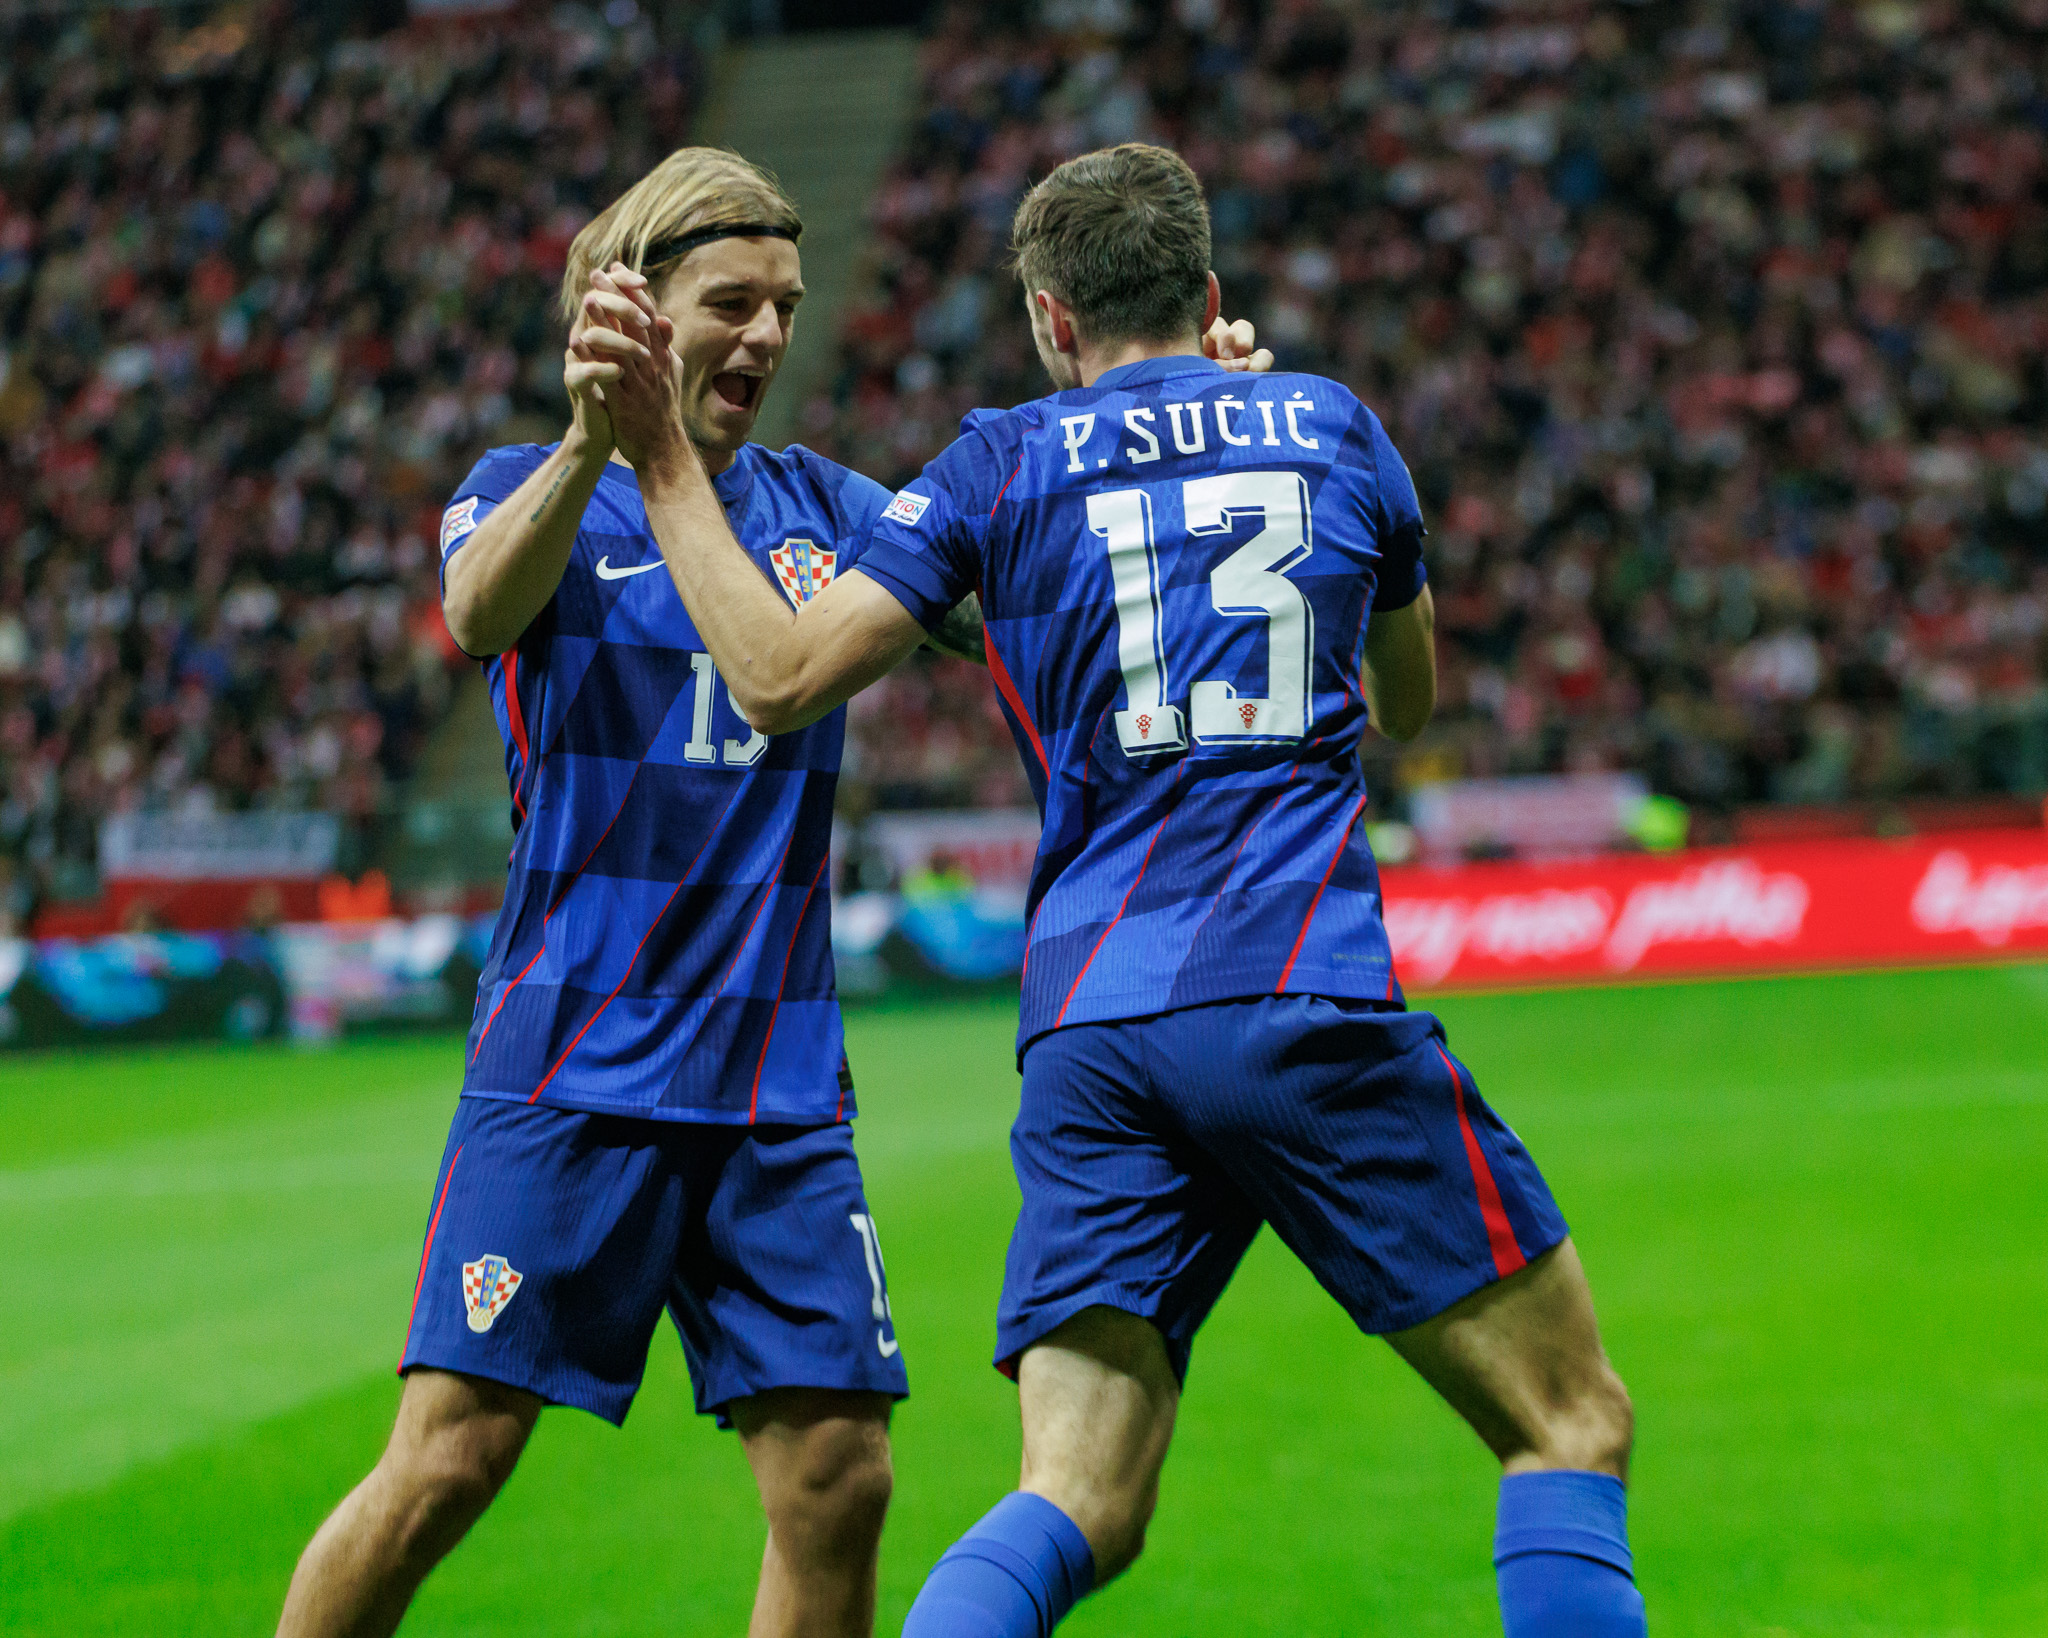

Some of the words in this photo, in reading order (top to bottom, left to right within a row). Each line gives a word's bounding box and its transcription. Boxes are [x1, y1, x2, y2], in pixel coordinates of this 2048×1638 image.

[1060, 413, 1108, 473] P.
[1123, 390, 1320, 464] SUČIĆ
[795, 548, 811, 593] HNS
[1085, 471, 1315, 757] 13
